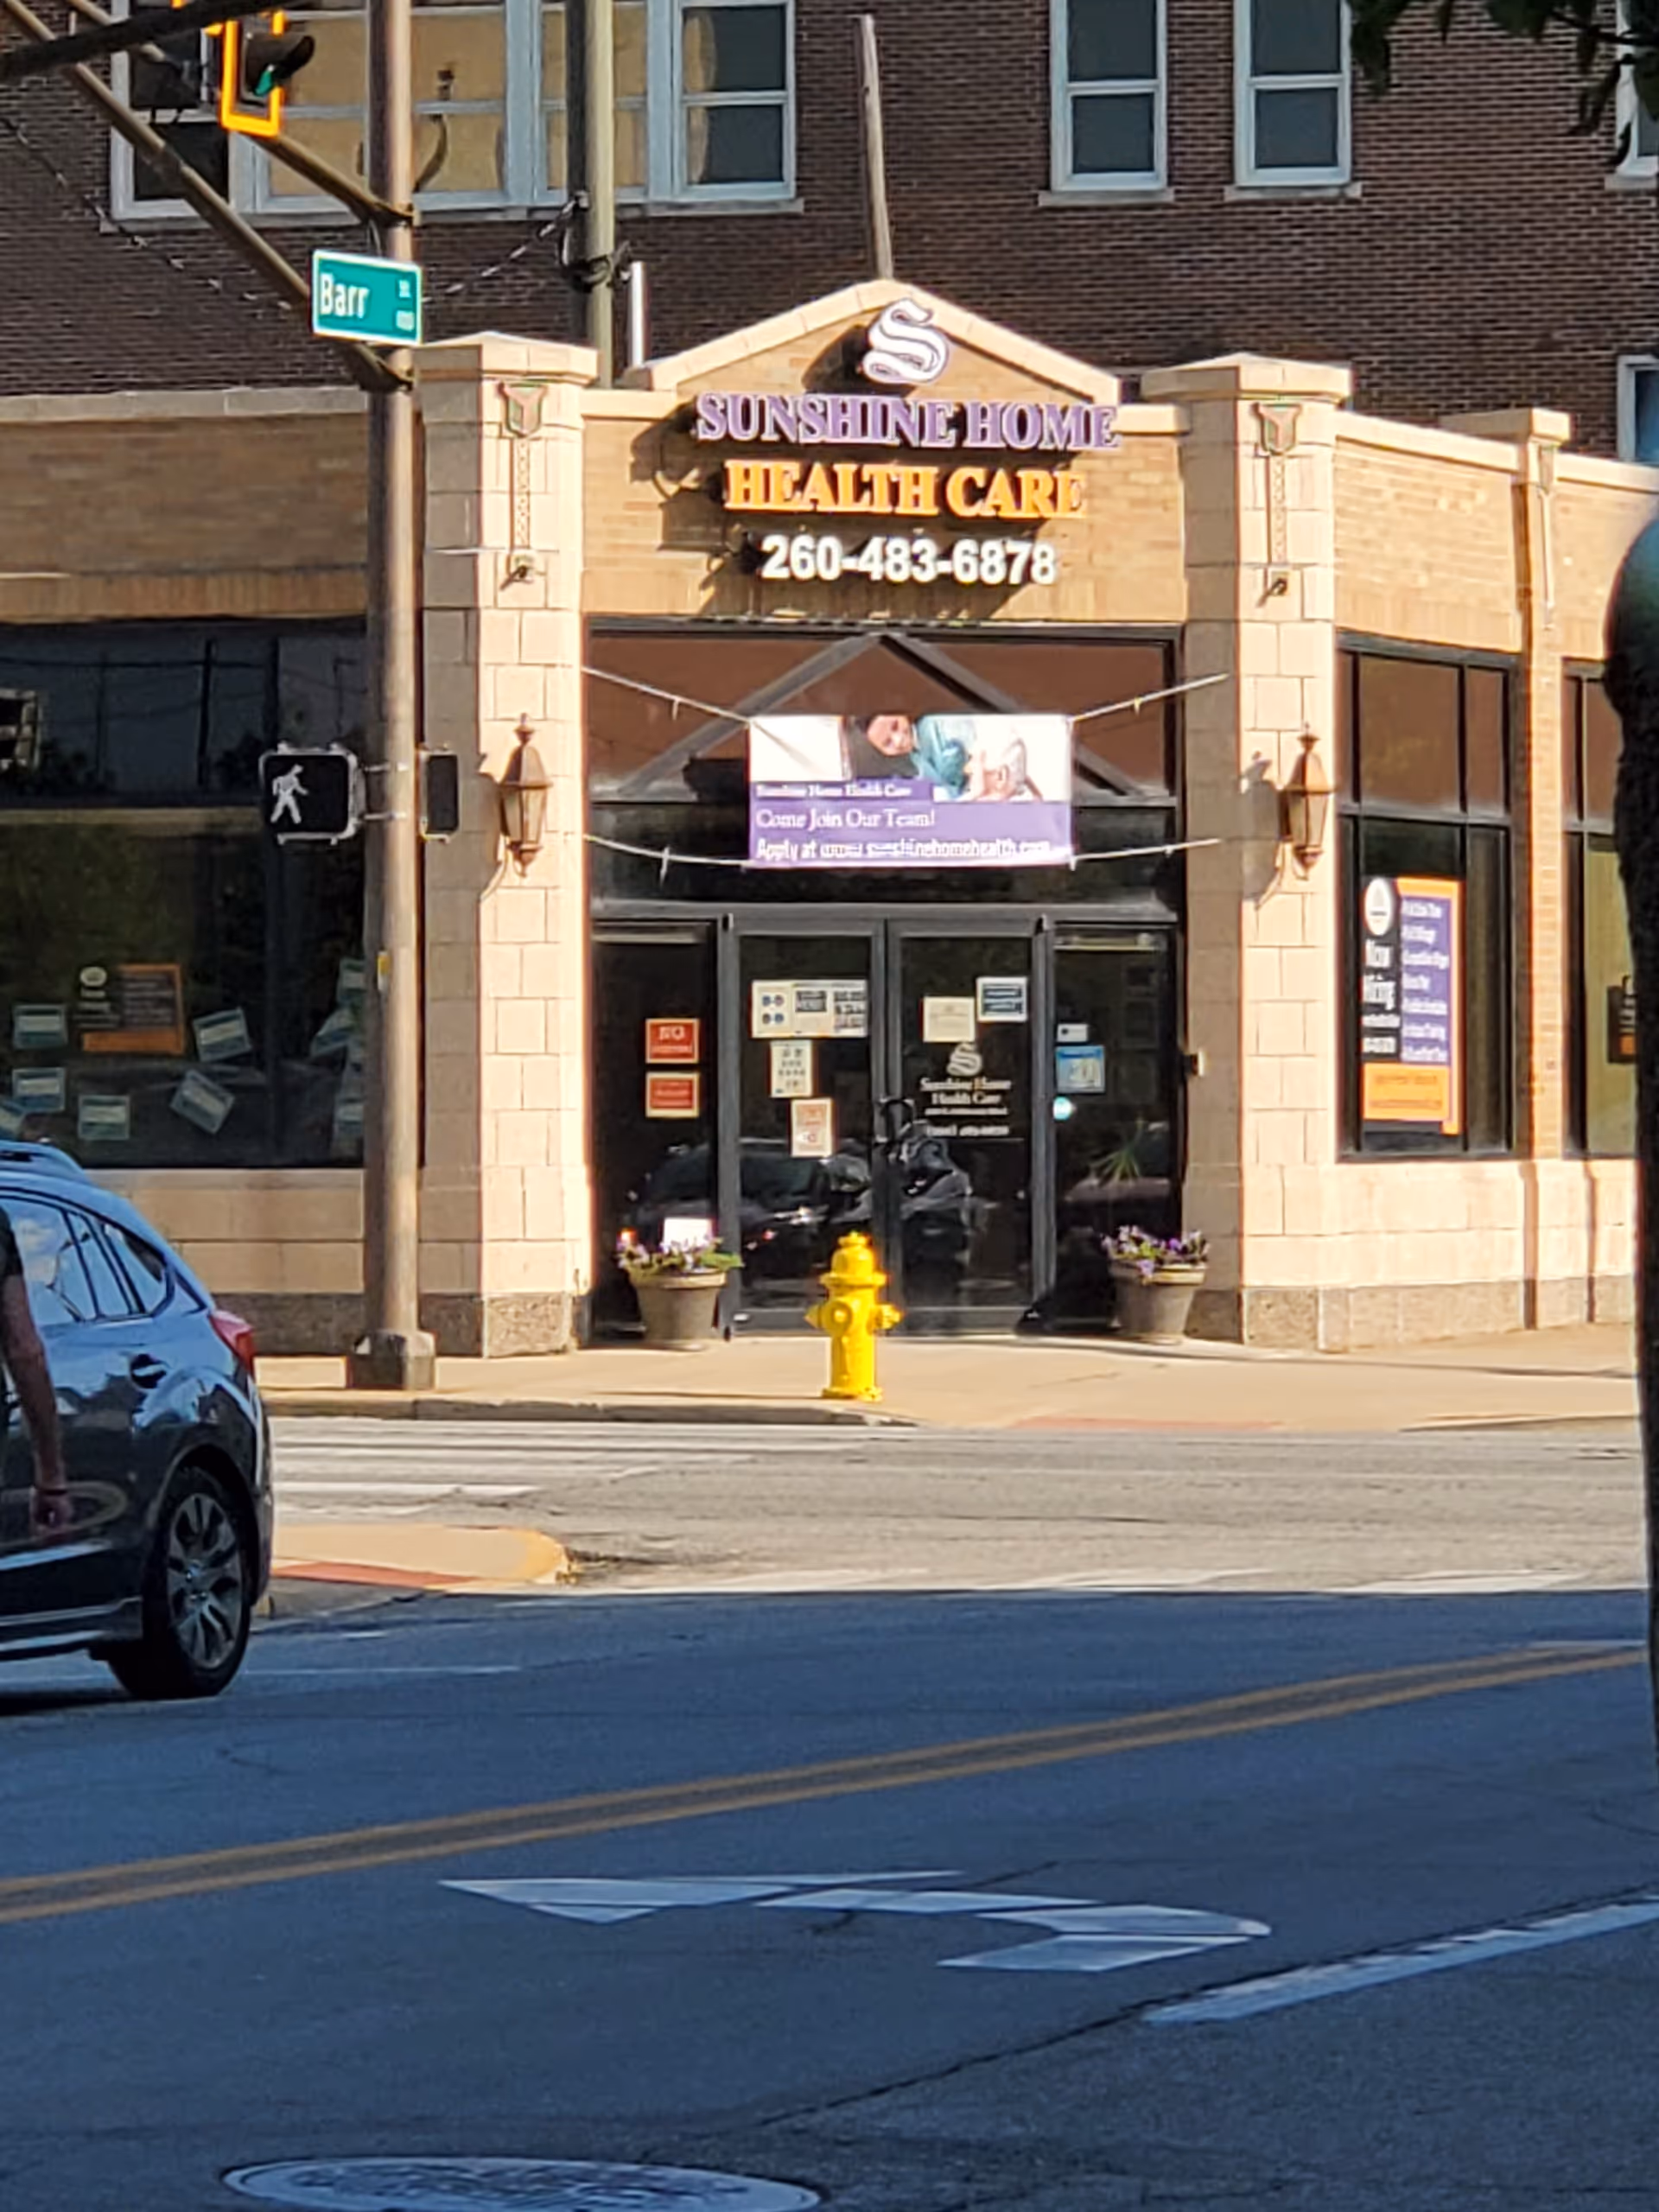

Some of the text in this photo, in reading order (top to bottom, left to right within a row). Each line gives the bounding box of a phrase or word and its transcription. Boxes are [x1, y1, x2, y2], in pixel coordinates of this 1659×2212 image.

[319, 272, 370, 319] Barr
[695, 391, 1122, 450] SUNSHINE HOME
[724, 459, 1086, 519] HEALTH CARE
[760, 534, 1057, 585] 260-483-6878
[756, 808, 936, 831] Come Join Our Team!
